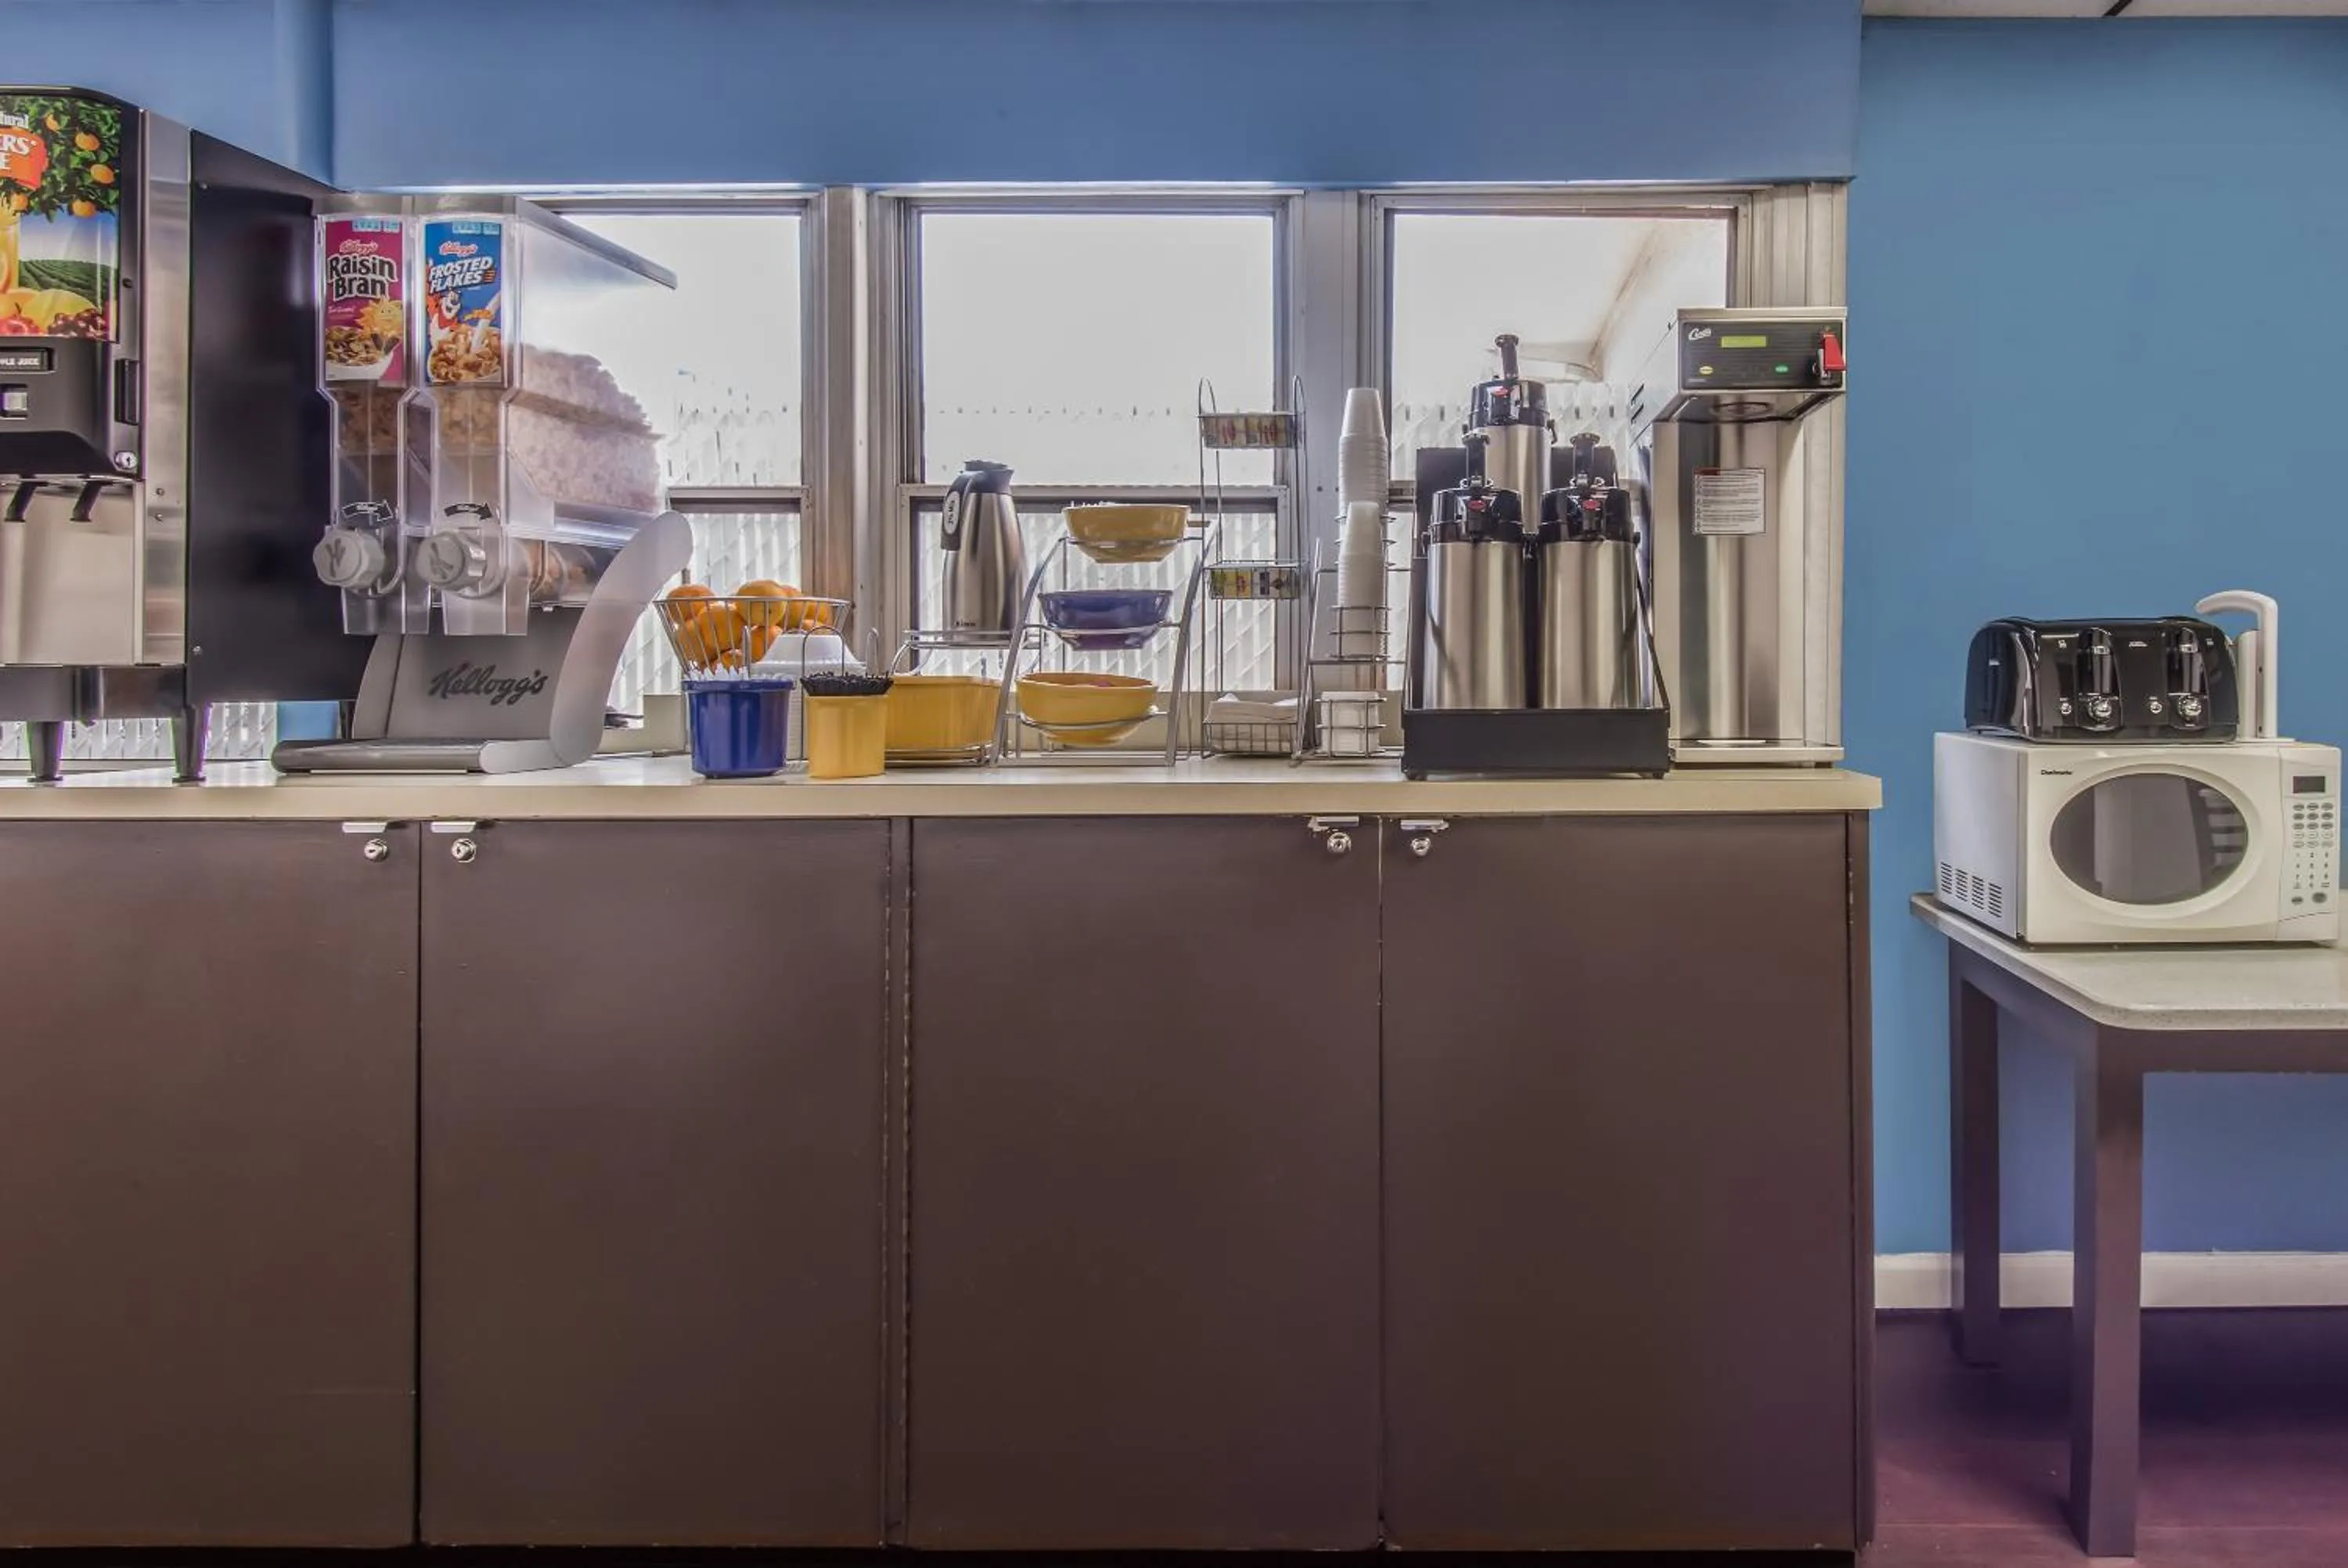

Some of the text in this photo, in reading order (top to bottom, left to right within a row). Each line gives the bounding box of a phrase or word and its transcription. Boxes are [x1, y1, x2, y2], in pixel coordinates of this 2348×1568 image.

[327, 254, 397, 282] Raisin
[430, 257, 492, 282] FROSTED
[333, 275, 388, 301] Bran
[430, 270, 483, 294] FLAKES
[428, 664, 549, 705] Kellogg's
